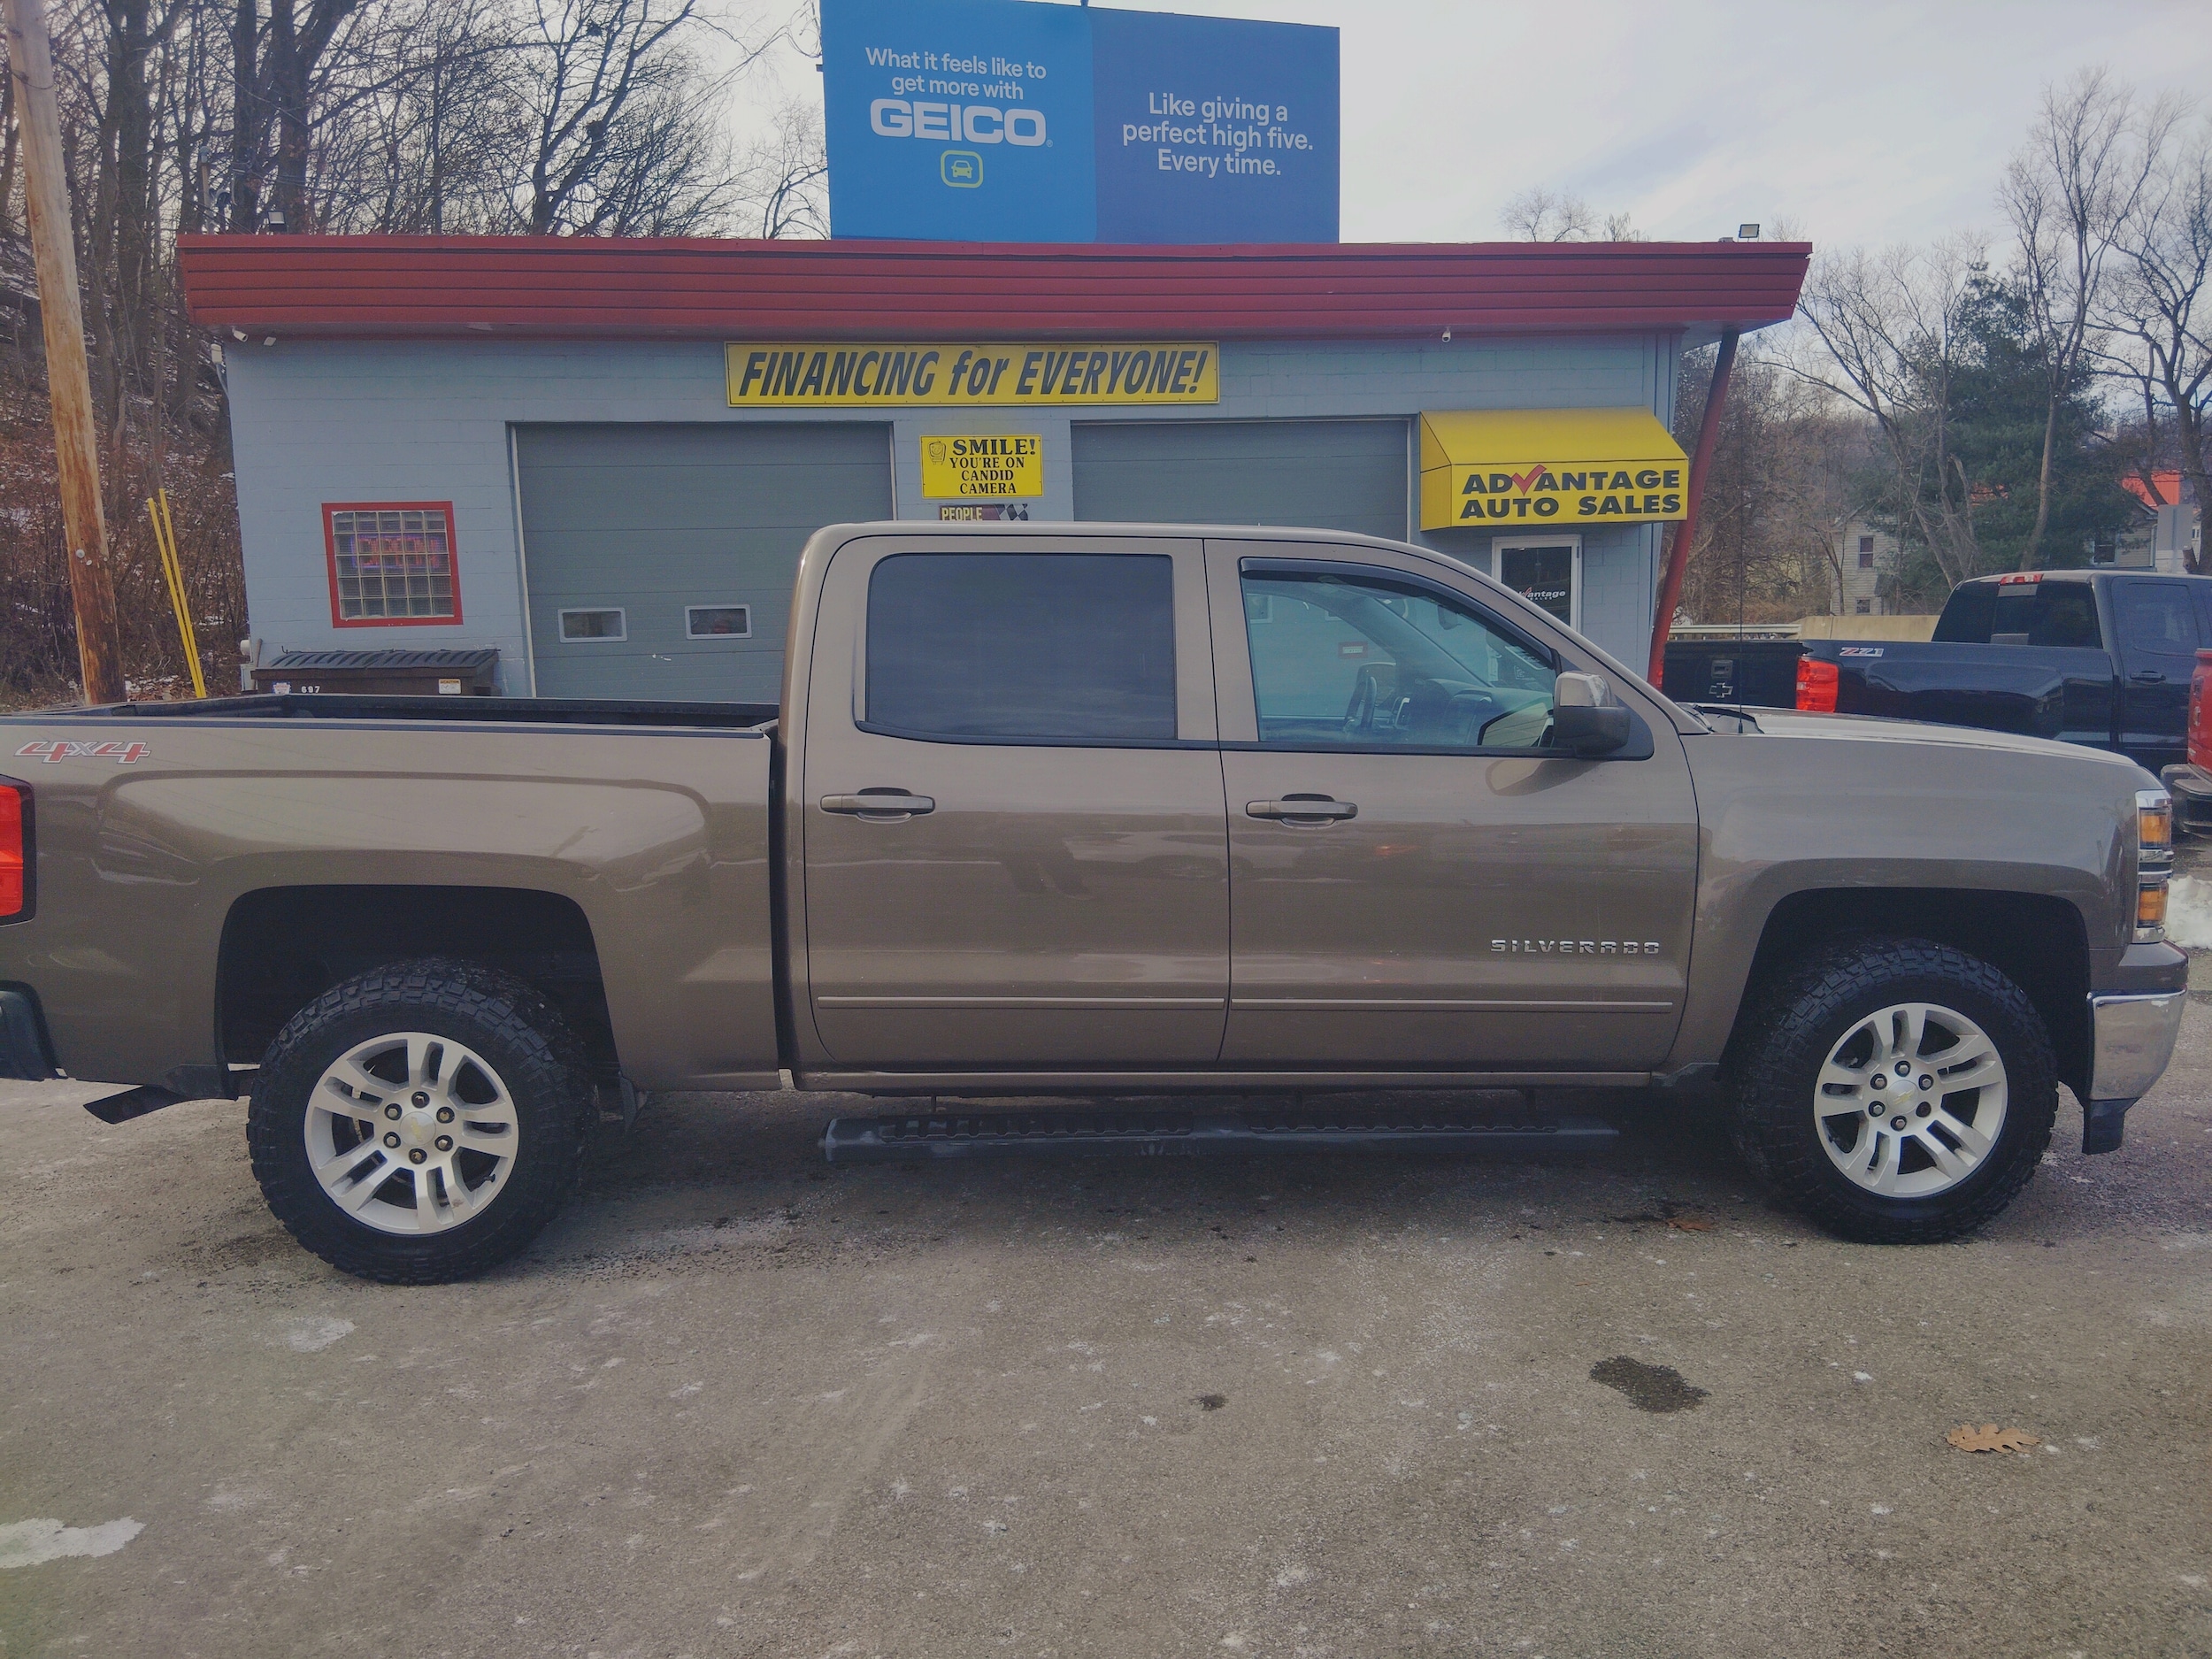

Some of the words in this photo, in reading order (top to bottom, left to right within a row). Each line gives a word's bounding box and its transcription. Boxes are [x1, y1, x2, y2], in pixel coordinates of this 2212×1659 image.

[865, 47, 920, 69] What
[925, 51, 938, 71] it
[941, 53, 987, 74] feels
[991, 57, 1023, 78] like
[1026, 61, 1047, 79] to
[892, 75, 925, 96] get
[929, 80, 979, 96] more
[983, 81, 1024, 100] with
[1149, 92, 1195, 116] Like
[1202, 96, 1270, 126] giving
[1276, 105, 1288, 121] a
[870, 98, 1047, 147] GEICO
[1123, 120, 1207, 146] perfect
[1212, 123, 1262, 152] high
[1267, 127, 1313, 150] five.
[1158, 148, 1220, 178] Every
[1225, 151, 1281, 175] time.
[738, 350, 940, 396] FINANCING
[948, 349, 1010, 396] for
[1015, 350, 1209, 395] EVERYONE!
[952, 439, 1035, 455] SMILE!
[949, 457, 1000, 468] YOU'RE
[1005, 457, 1025, 468] ON
[961, 470, 1014, 480] CANDID
[960, 483, 1017, 494] CAMERA
[1462, 465, 1680, 496] ADVANTAGE
[941, 507, 983, 520] PEOPLE
[1460, 497, 1560, 519] AUTO
[1578, 494, 1681, 515] SALES
[1839, 647, 1884, 657] Z71
[1491, 939, 1660, 954] SILVERADO
